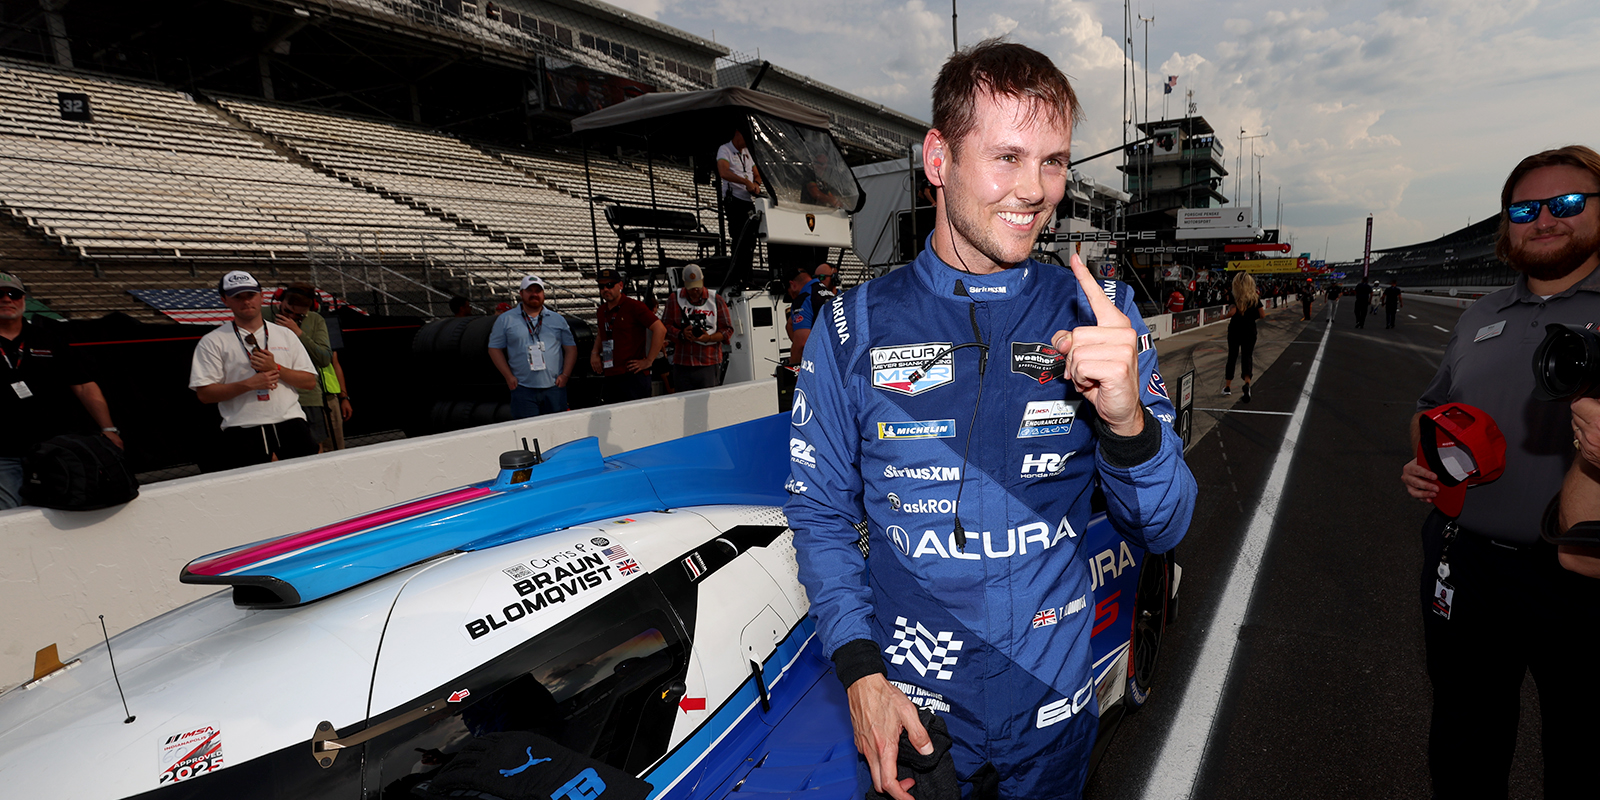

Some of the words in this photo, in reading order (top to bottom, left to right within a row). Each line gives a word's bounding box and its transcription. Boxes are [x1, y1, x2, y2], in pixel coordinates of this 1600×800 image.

[62, 99, 83, 113] 32
[1237, 211, 1244, 222] 6
[1055, 231, 1157, 242] PORSCHE
[1267, 232, 1274, 242] 7
[1299, 258, 1306, 268] 3
[888, 347, 948, 361] ACURA
[896, 425, 948, 435] MICHELIN
[1025, 418, 1058, 428] ENDURANCE
[883, 464, 960, 481] SiriusXM
[1020, 471, 1049, 479] Honda
[912, 515, 1077, 561] ACURA
[530, 550, 577, 569] Chris
[512, 552, 605, 597] BRAUN
[464, 565, 615, 640] BLOMQVIST
[1036, 676, 1093, 729] 60
[181, 726, 214, 740] IMSA
[163, 735, 207, 751] INDIANAPOLIS
[173, 750, 223, 769] APPROVED
[159, 757, 224, 785] 2025
